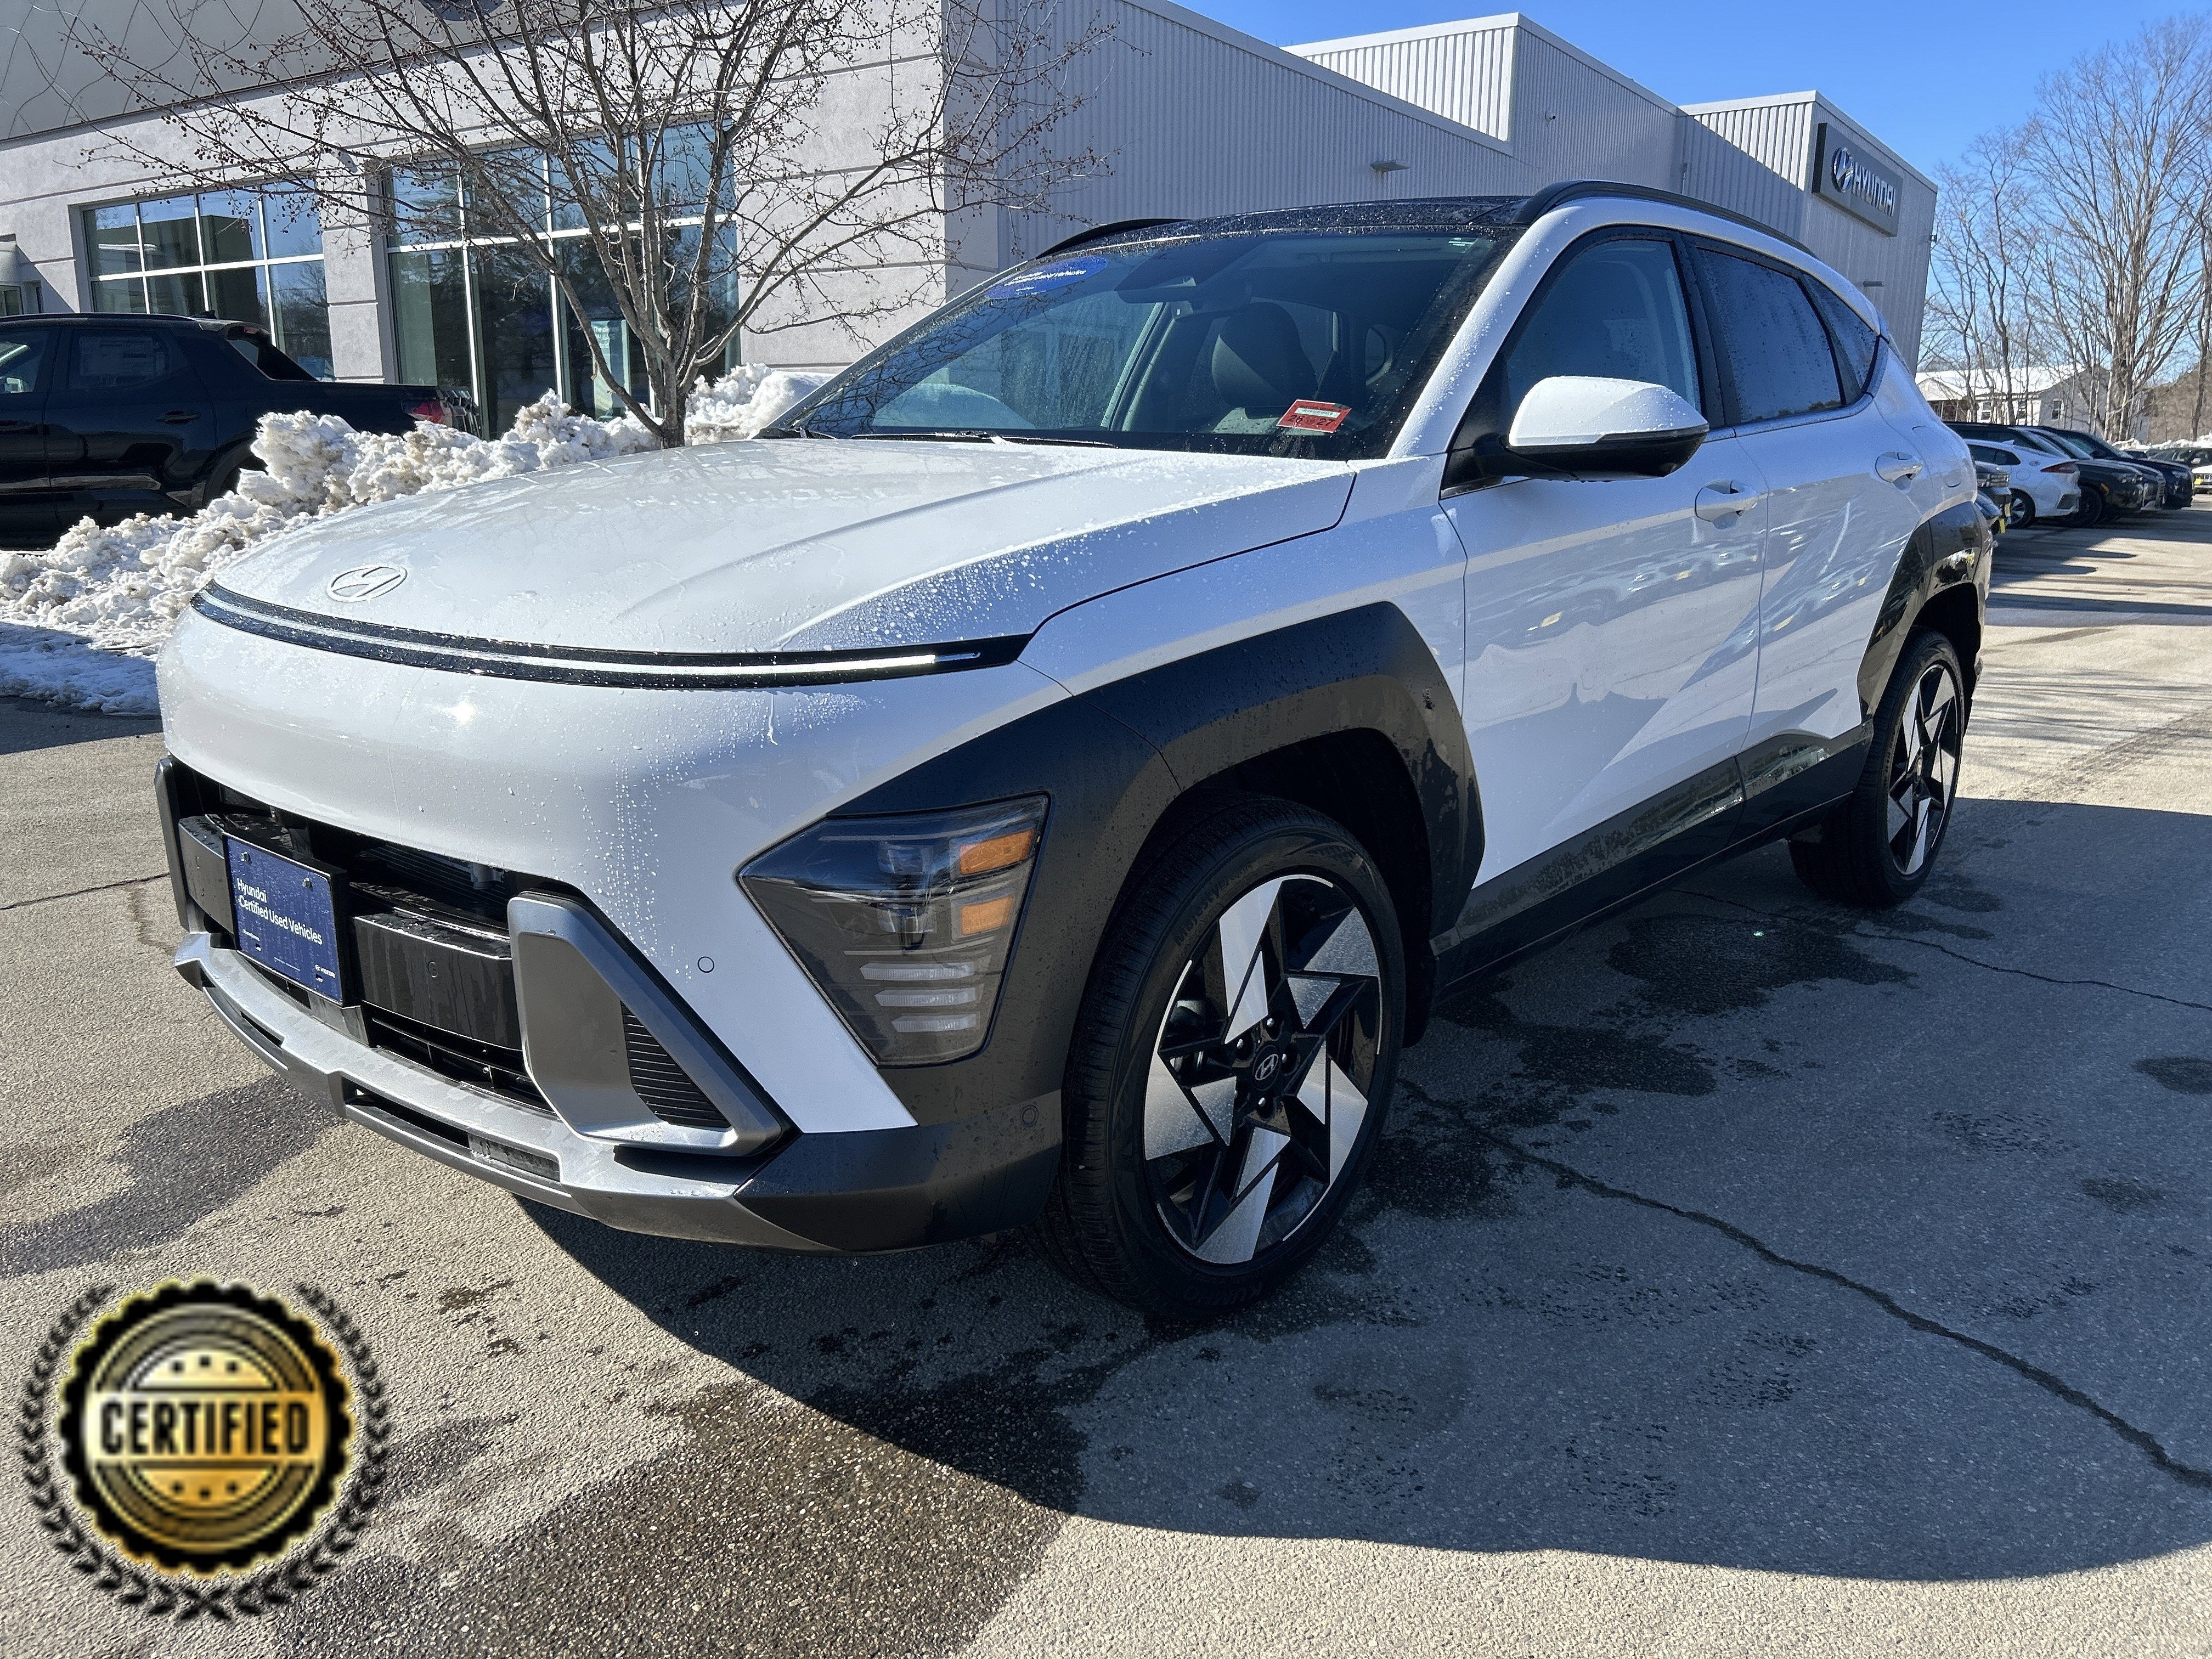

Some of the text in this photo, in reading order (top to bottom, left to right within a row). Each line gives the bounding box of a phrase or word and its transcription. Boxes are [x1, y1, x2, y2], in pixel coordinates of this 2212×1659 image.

[1852, 161, 1895, 217] HYUNDAI
[1317, 417, 1335, 426] 27
[237, 878, 267, 903] Hyundai
[238, 895, 268, 920] Certified
[269, 909, 289, 929] Used
[288, 918, 323, 945] Vehicles
